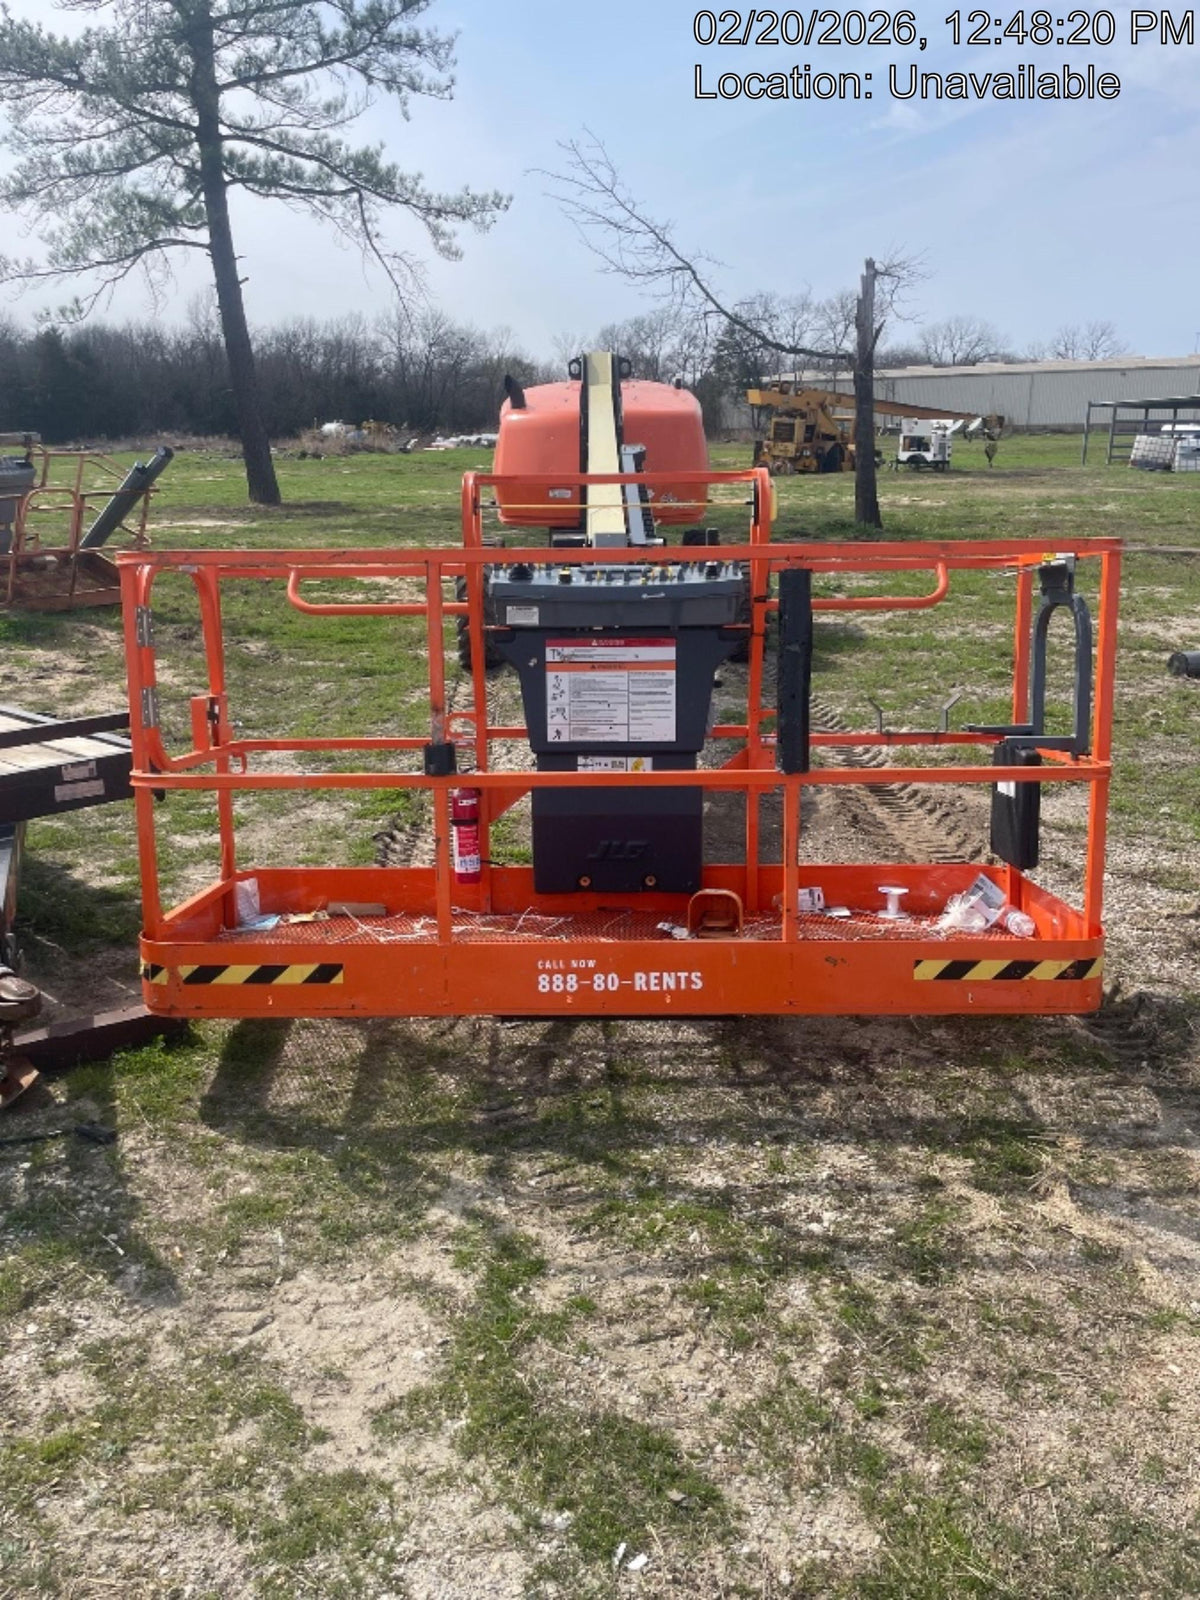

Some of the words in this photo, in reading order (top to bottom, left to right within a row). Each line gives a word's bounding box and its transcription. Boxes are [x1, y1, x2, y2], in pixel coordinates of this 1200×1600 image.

[586, 839, 650, 859] JLG
[537, 959, 566, 970] CALL
[571, 959, 597, 969] NOW
[537, 971, 703, 993] 888-80-RENTS
